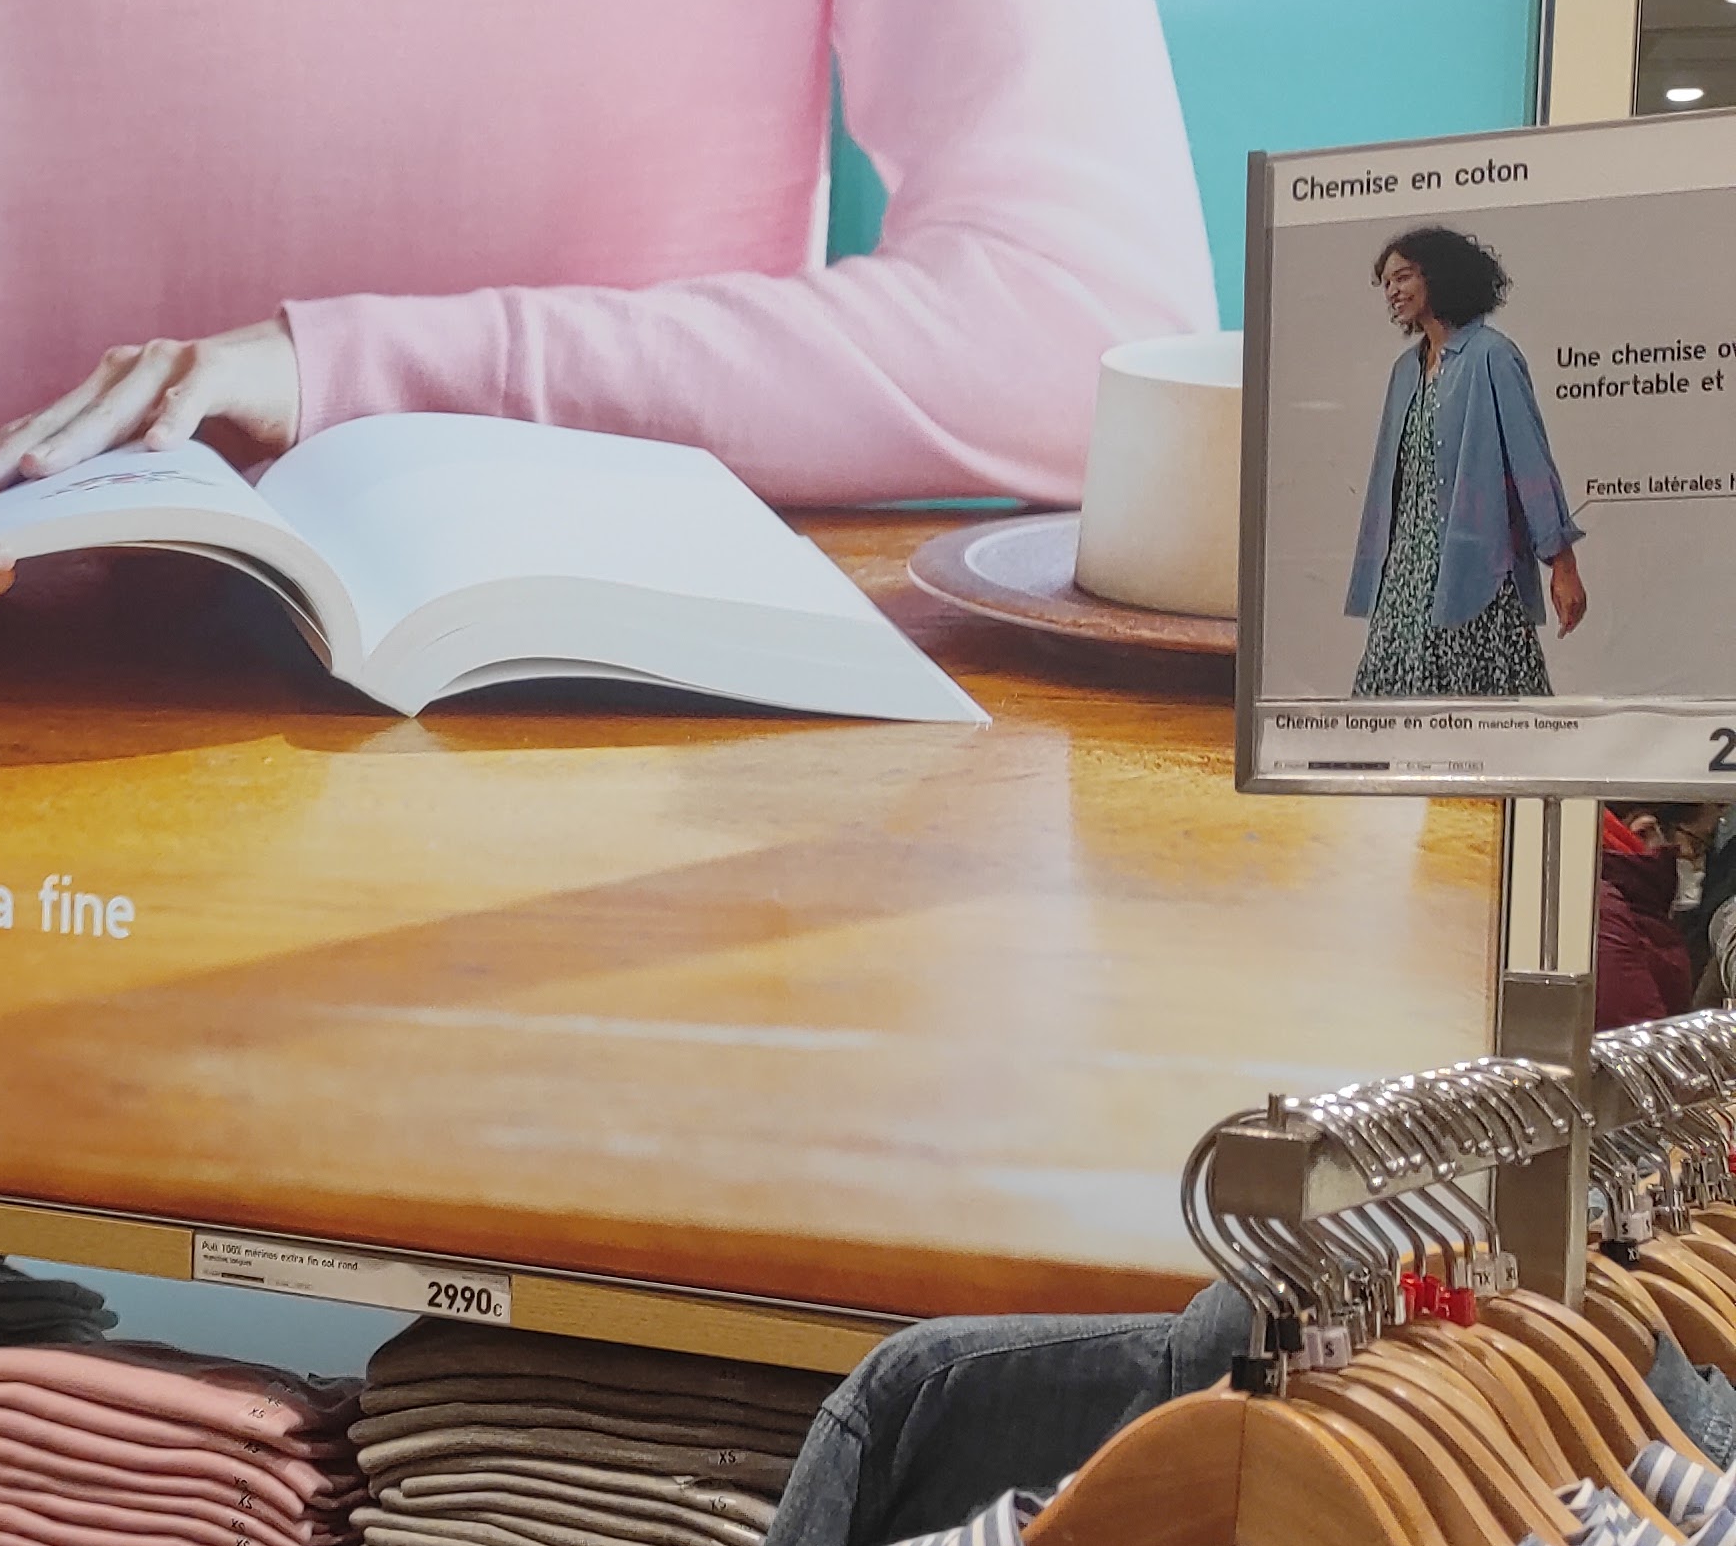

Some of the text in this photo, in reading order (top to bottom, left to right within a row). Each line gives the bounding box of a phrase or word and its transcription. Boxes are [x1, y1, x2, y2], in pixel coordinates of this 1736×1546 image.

[1292, 159, 1529, 201] Chemise en coton
[1557, 346, 1601, 369] Une
[1612, 339, 1707, 366] chemise
[1555, 369, 1724, 400] confortable et
[1586, 477, 1641, 495] Fentes
[1648, 474, 1722, 493] latérales
[1275, 713, 1579, 733] Chemise longue en coton manches longues
[38, 875, 137, 940] fine
[280, 1253, 304, 1264] extra
[307, 1254, 319, 1266] fin
[338, 1259, 359, 1271] rond
